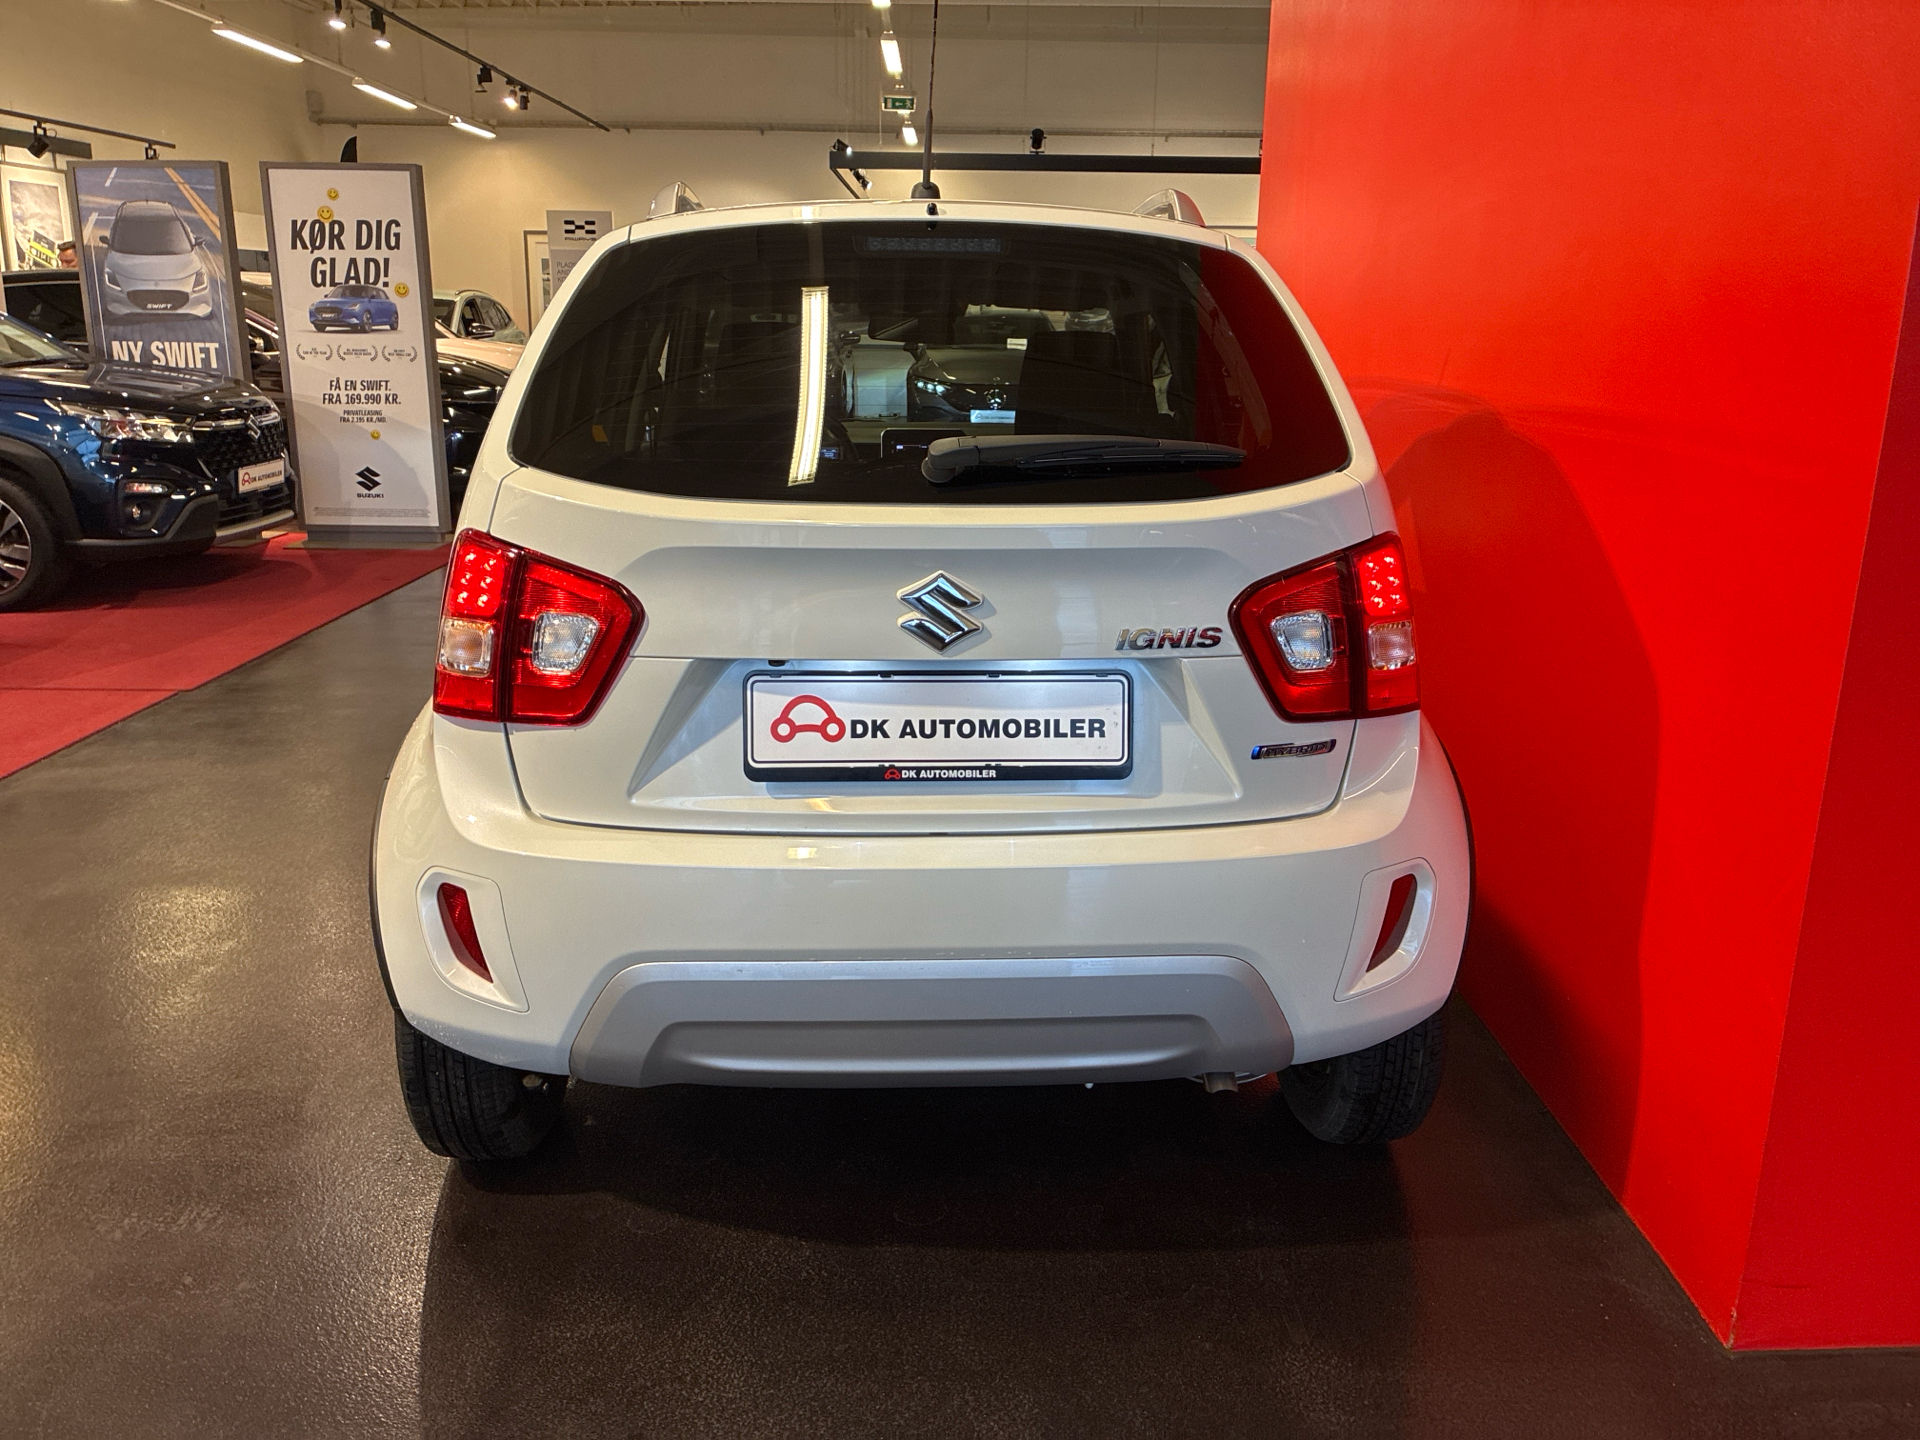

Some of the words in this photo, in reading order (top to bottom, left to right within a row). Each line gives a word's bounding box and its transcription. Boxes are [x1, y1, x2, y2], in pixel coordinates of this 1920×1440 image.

[291, 219, 346, 254] KØR
[356, 219, 401, 250] DIG
[310, 257, 389, 288] GLAD!
[111, 341, 143, 362] NY
[150, 341, 219, 368] SWIFT
[329, 376, 342, 391] FÅ
[344, 379, 357, 391] EN
[360, 379, 392, 391] SWIFT.
[322, 393, 342, 405] FRA
[345, 393, 382, 405] 169.990
[384, 393, 402, 405] KR.
[1115, 627, 1223, 650] IGNIS
[850, 718, 891, 739] DK
[899, 718, 1106, 739] AUTOMOBILER
[1262, 742, 1329, 758] HYBRID
[901, 769, 918, 779] DK
[919, 769, 997, 779] AUTOMOBILER
